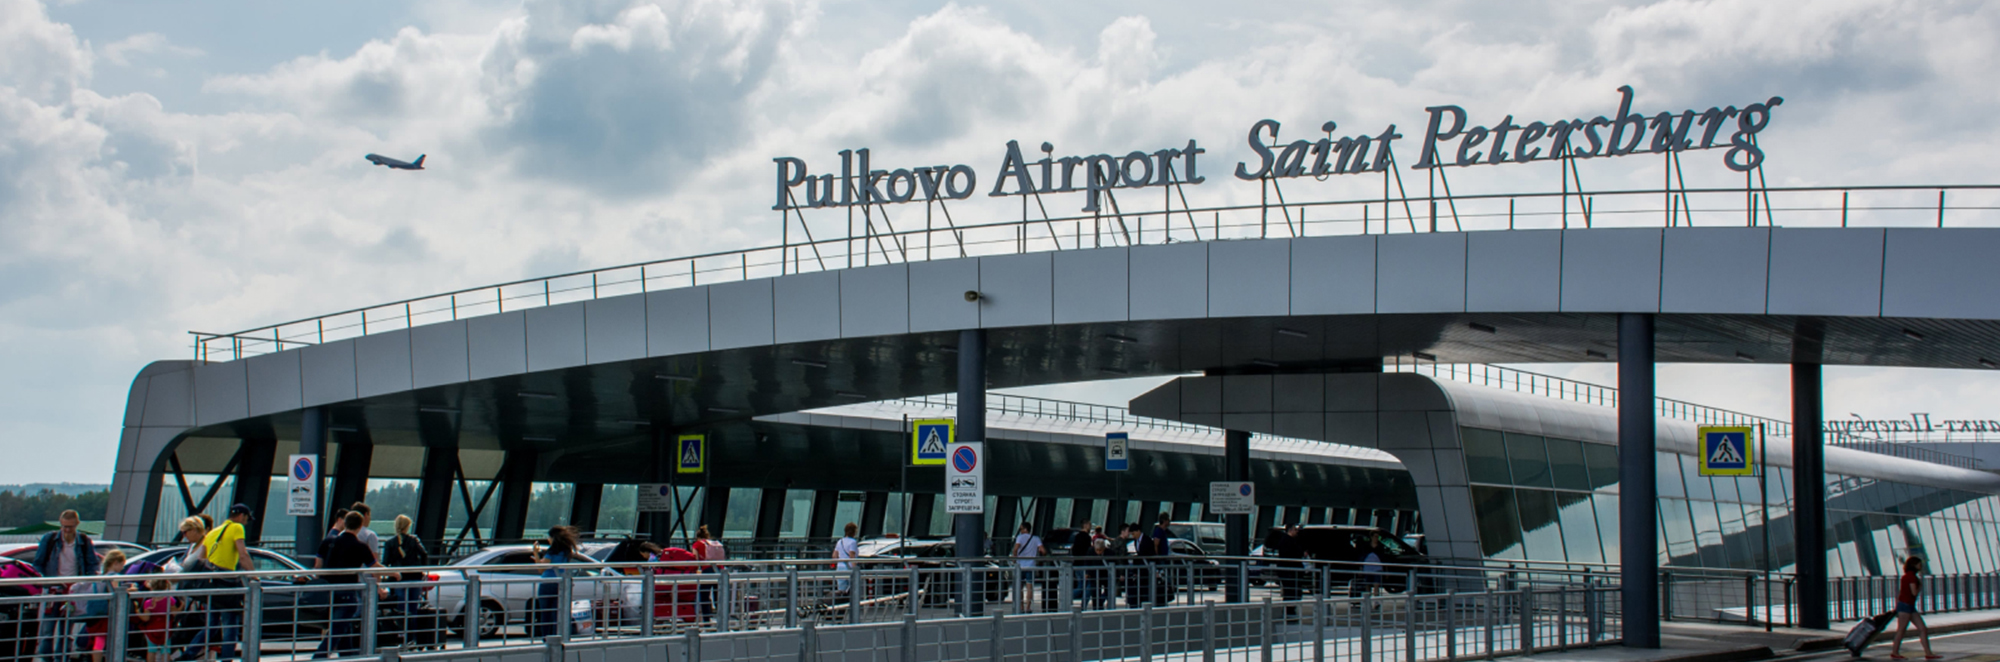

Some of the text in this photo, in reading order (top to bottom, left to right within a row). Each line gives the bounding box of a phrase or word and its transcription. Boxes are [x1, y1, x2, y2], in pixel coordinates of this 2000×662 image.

[772, 85, 1784, 212] Pulkovo Airport Saint Petersburg
